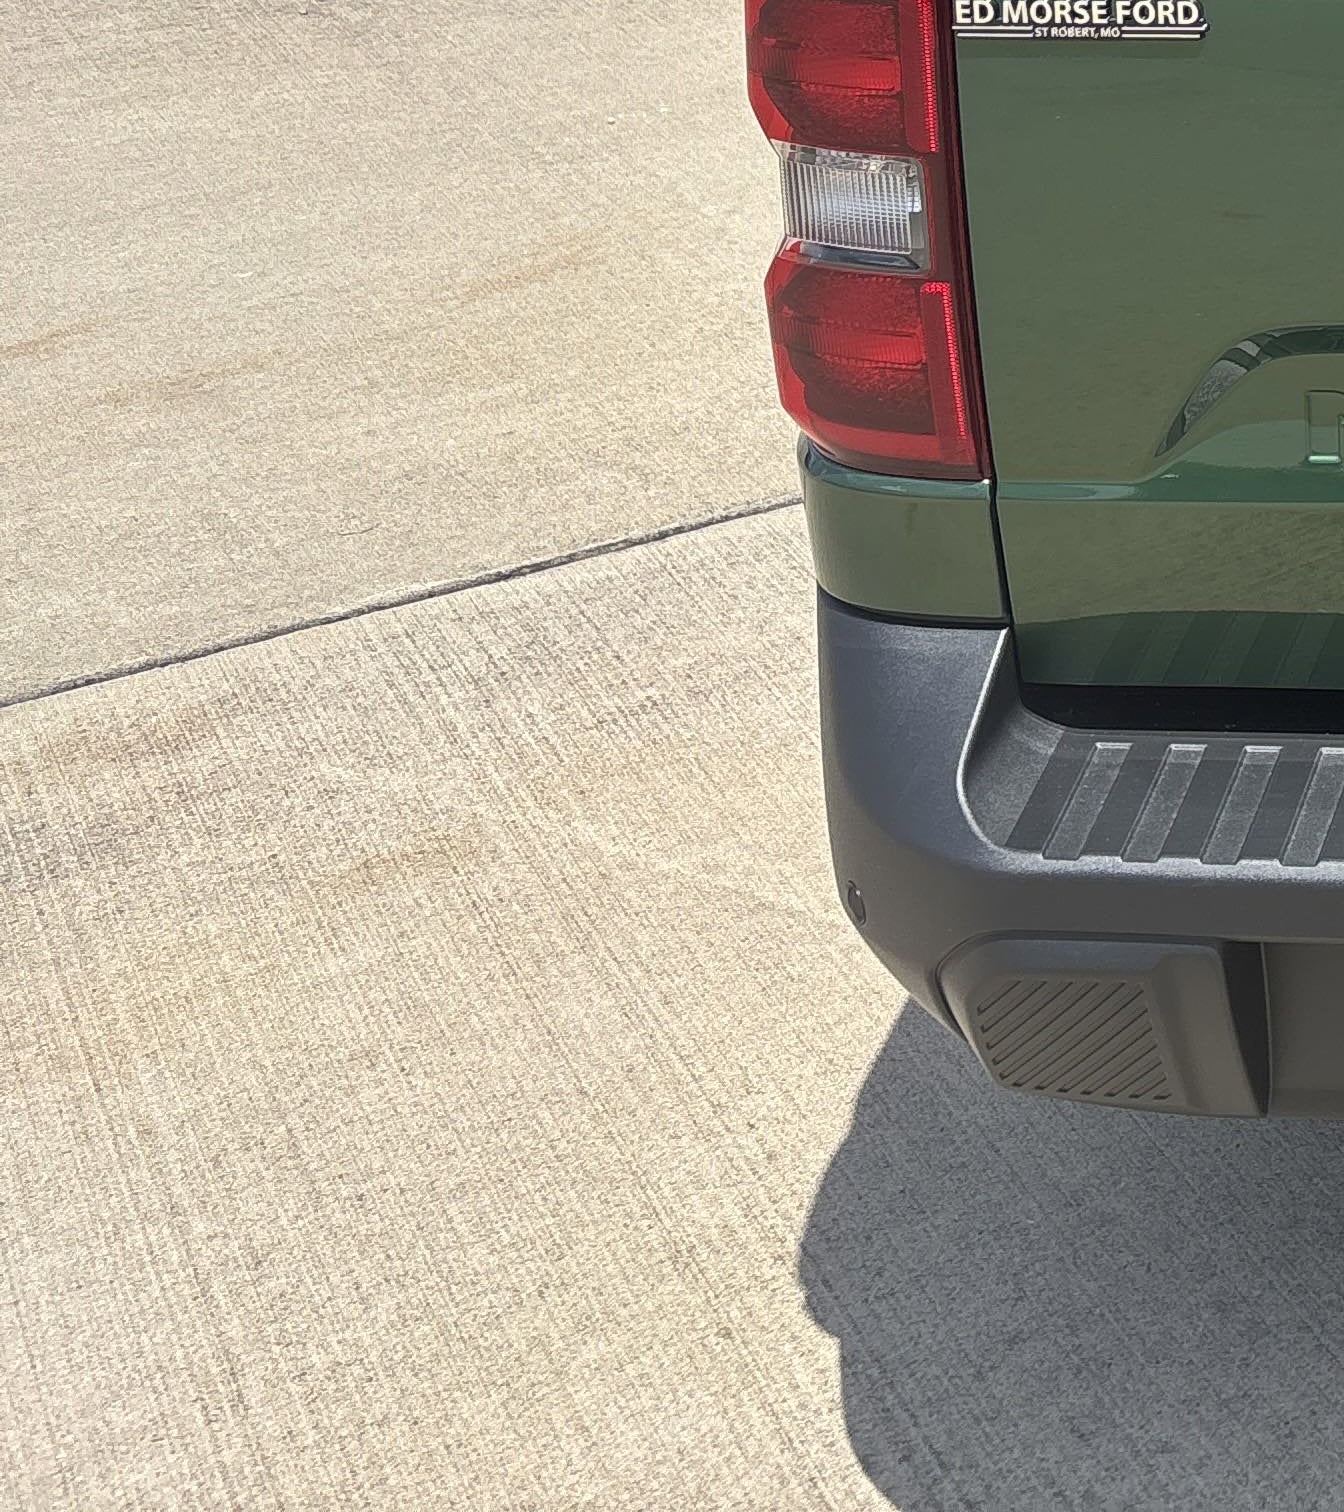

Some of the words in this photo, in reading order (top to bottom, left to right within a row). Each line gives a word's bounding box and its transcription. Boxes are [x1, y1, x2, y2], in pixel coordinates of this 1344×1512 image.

[1034, 26, 1048, 38] ST
[1050, 26, 1098, 39] ROBERT,
[1100, 26, 1120, 38] MO
